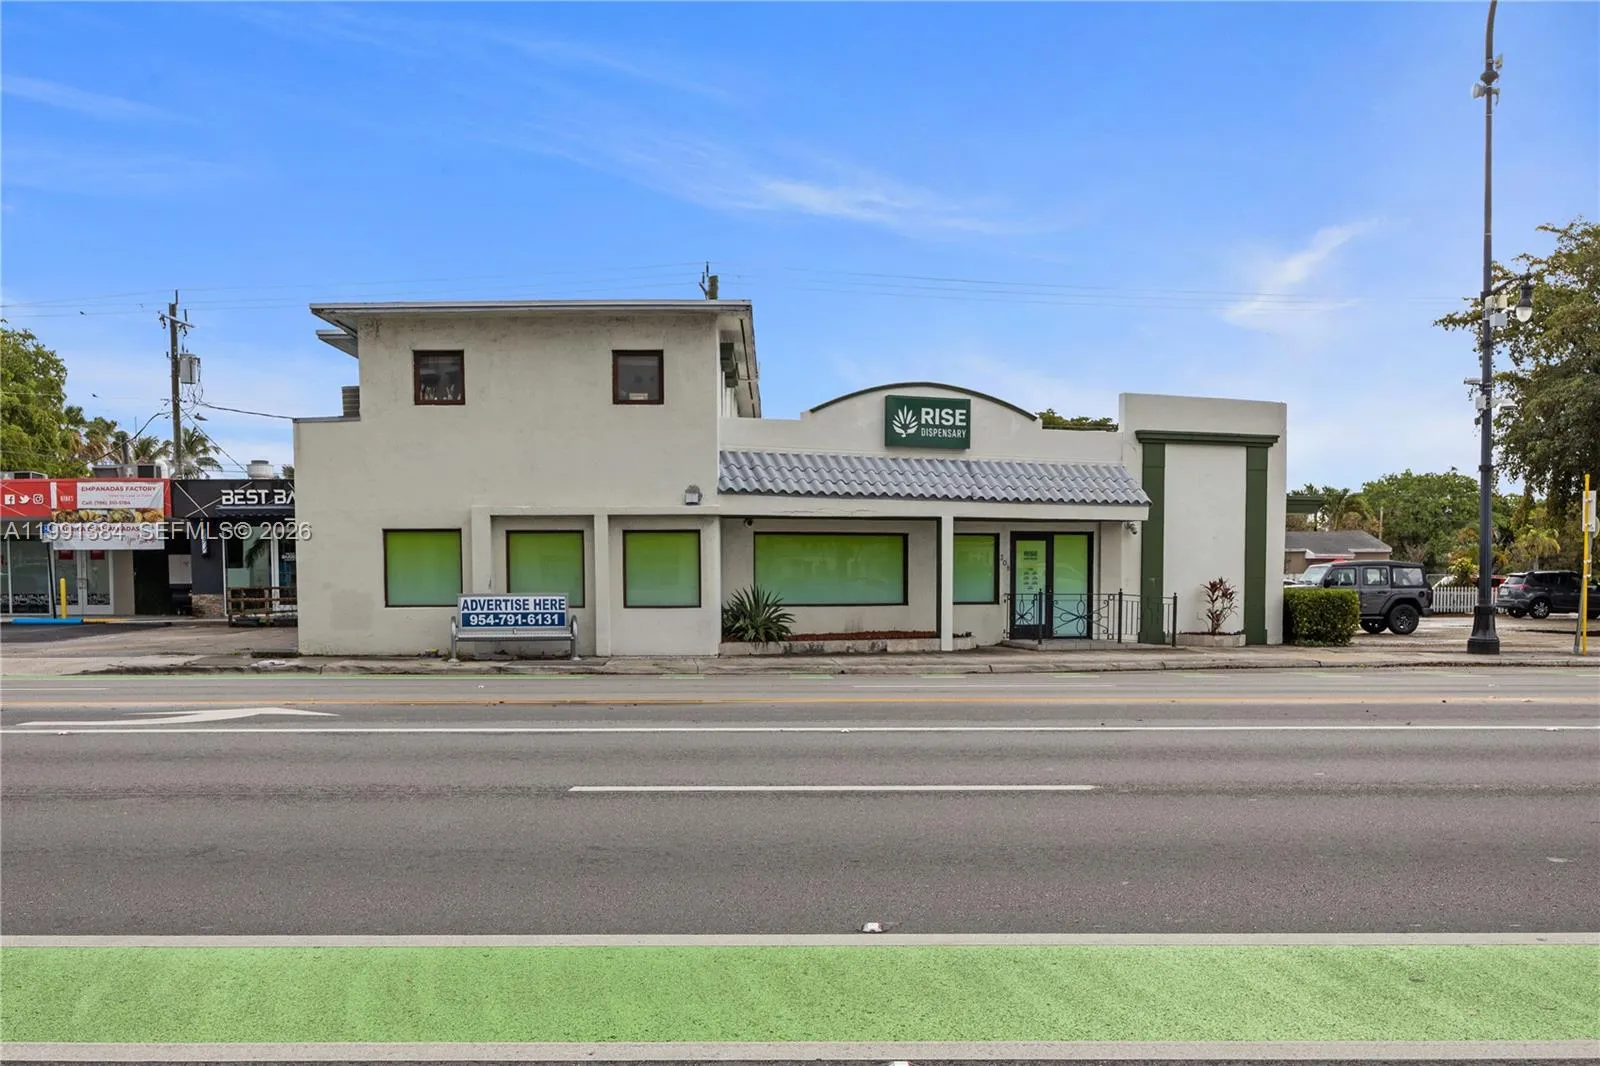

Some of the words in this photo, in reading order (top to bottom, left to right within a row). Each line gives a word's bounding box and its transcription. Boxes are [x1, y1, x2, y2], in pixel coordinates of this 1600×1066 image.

[920, 408, 967, 426] RISE
[920, 427, 967, 438] DISPENSARY
[81, 485, 124, 493] EMPANADAS
[221, 489, 269, 505] BEST
[462, 599, 530, 611] ADVERTISE
[534, 598, 565, 611] HERE
[469, 613, 559, 625] 954-791-6131
